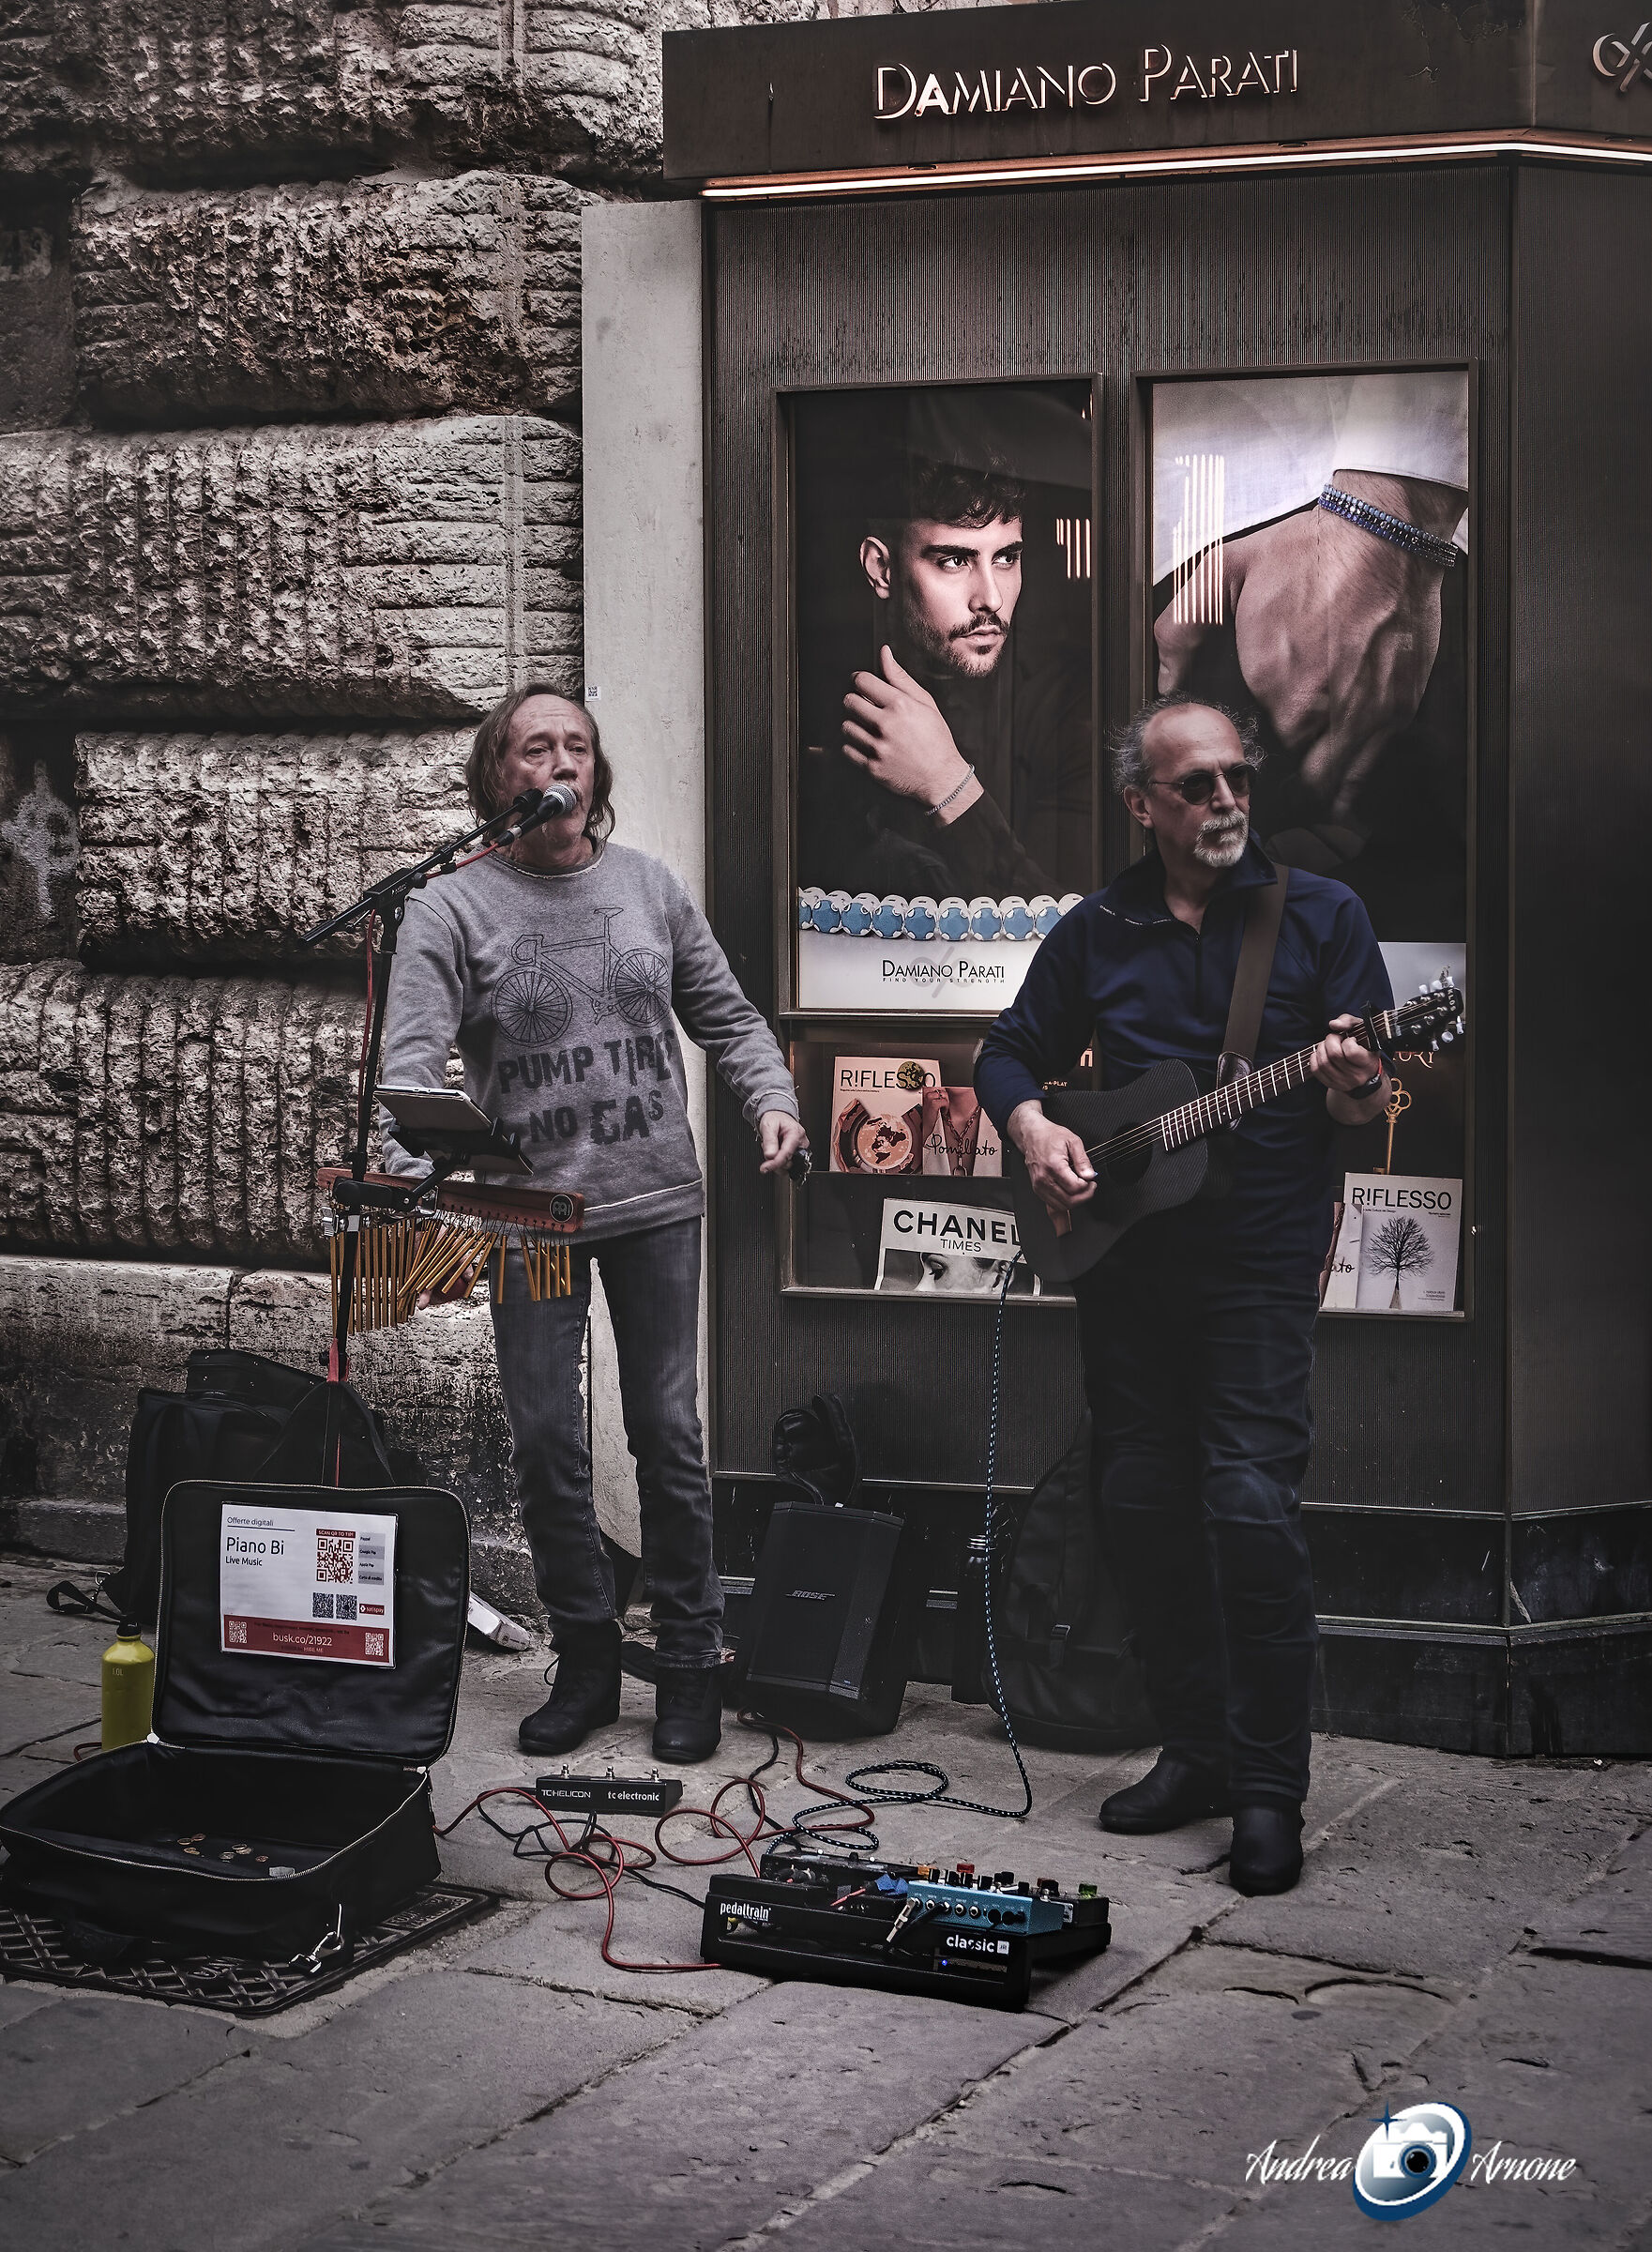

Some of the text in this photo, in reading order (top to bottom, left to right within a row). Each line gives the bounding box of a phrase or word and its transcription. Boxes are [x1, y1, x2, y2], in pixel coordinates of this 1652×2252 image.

[873, 43, 1299, 120] DAMIANO PARATI
[882, 959, 1005, 978] DAMIANO PARATI
[497, 1044, 594, 1093] PUMP
[529, 1089, 665, 1146] NO GAS
[925, 1134, 998, 1156] Pomellato
[893, 1210, 1021, 1246] CHANEL
[940, 1238, 981, 1253] TIMES
[227, 1516, 274, 1527] Offerte digitali
[226, 1536, 284, 1555] Piano Bi
[225, 1556, 263, 1566] Live Music
[272, 1633, 332, 1646] busk.co/21922
[608, 1790, 659, 1802] tc electronic
[720, 1902, 769, 1921] pedaltrain
[946, 1934, 995, 1953] classic
